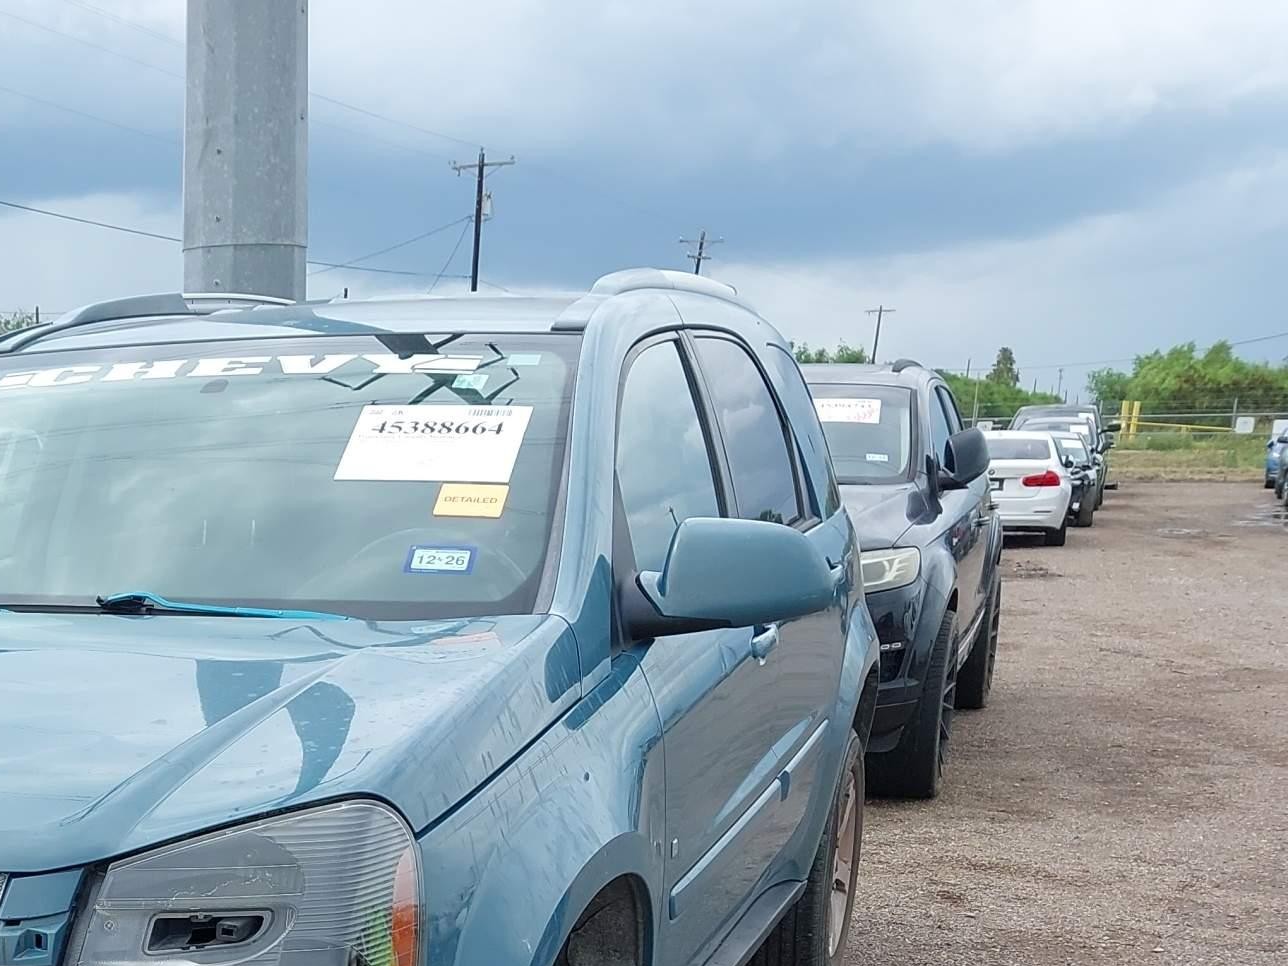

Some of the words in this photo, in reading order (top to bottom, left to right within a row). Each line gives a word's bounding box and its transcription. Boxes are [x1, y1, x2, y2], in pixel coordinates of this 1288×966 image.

[23, 354, 447, 388] CHEVY
[371, 420, 505, 435] 45388664
[443, 496, 499, 504] DETAILED
